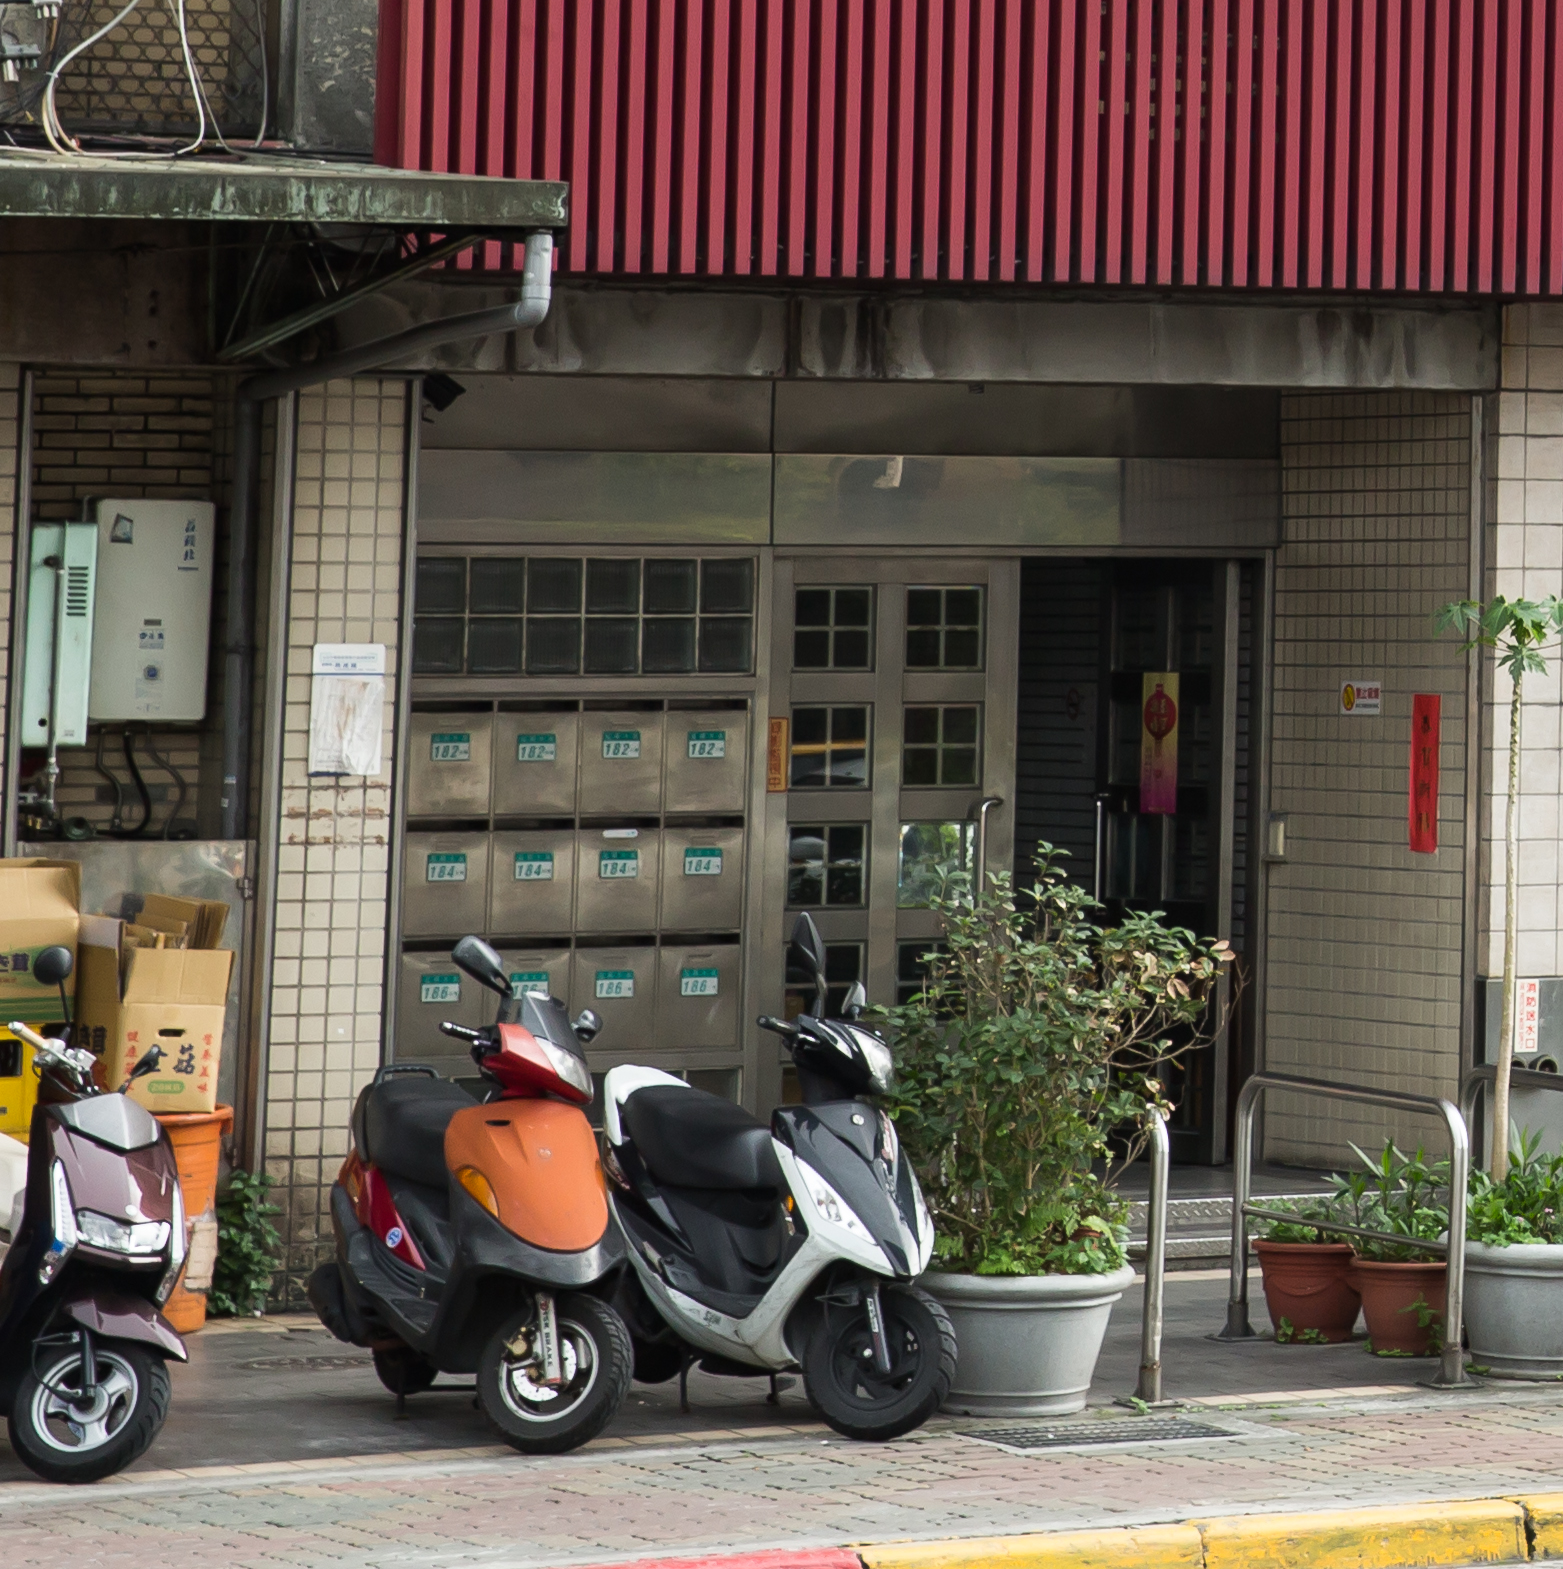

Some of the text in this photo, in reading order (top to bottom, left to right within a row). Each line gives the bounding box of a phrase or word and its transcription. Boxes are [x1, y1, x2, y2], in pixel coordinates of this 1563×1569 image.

[434, 745, 459, 758] 182
[521, 746, 546, 759] 182
[605, 743, 630, 756] 182
[691, 743, 716, 756] 182
[430, 865, 455, 878] 184
[518, 864, 543, 877] 184
[603, 862, 628, 875] 184
[687, 859, 712, 872] 184
[544, 1332, 554, 1368] BRAKE
